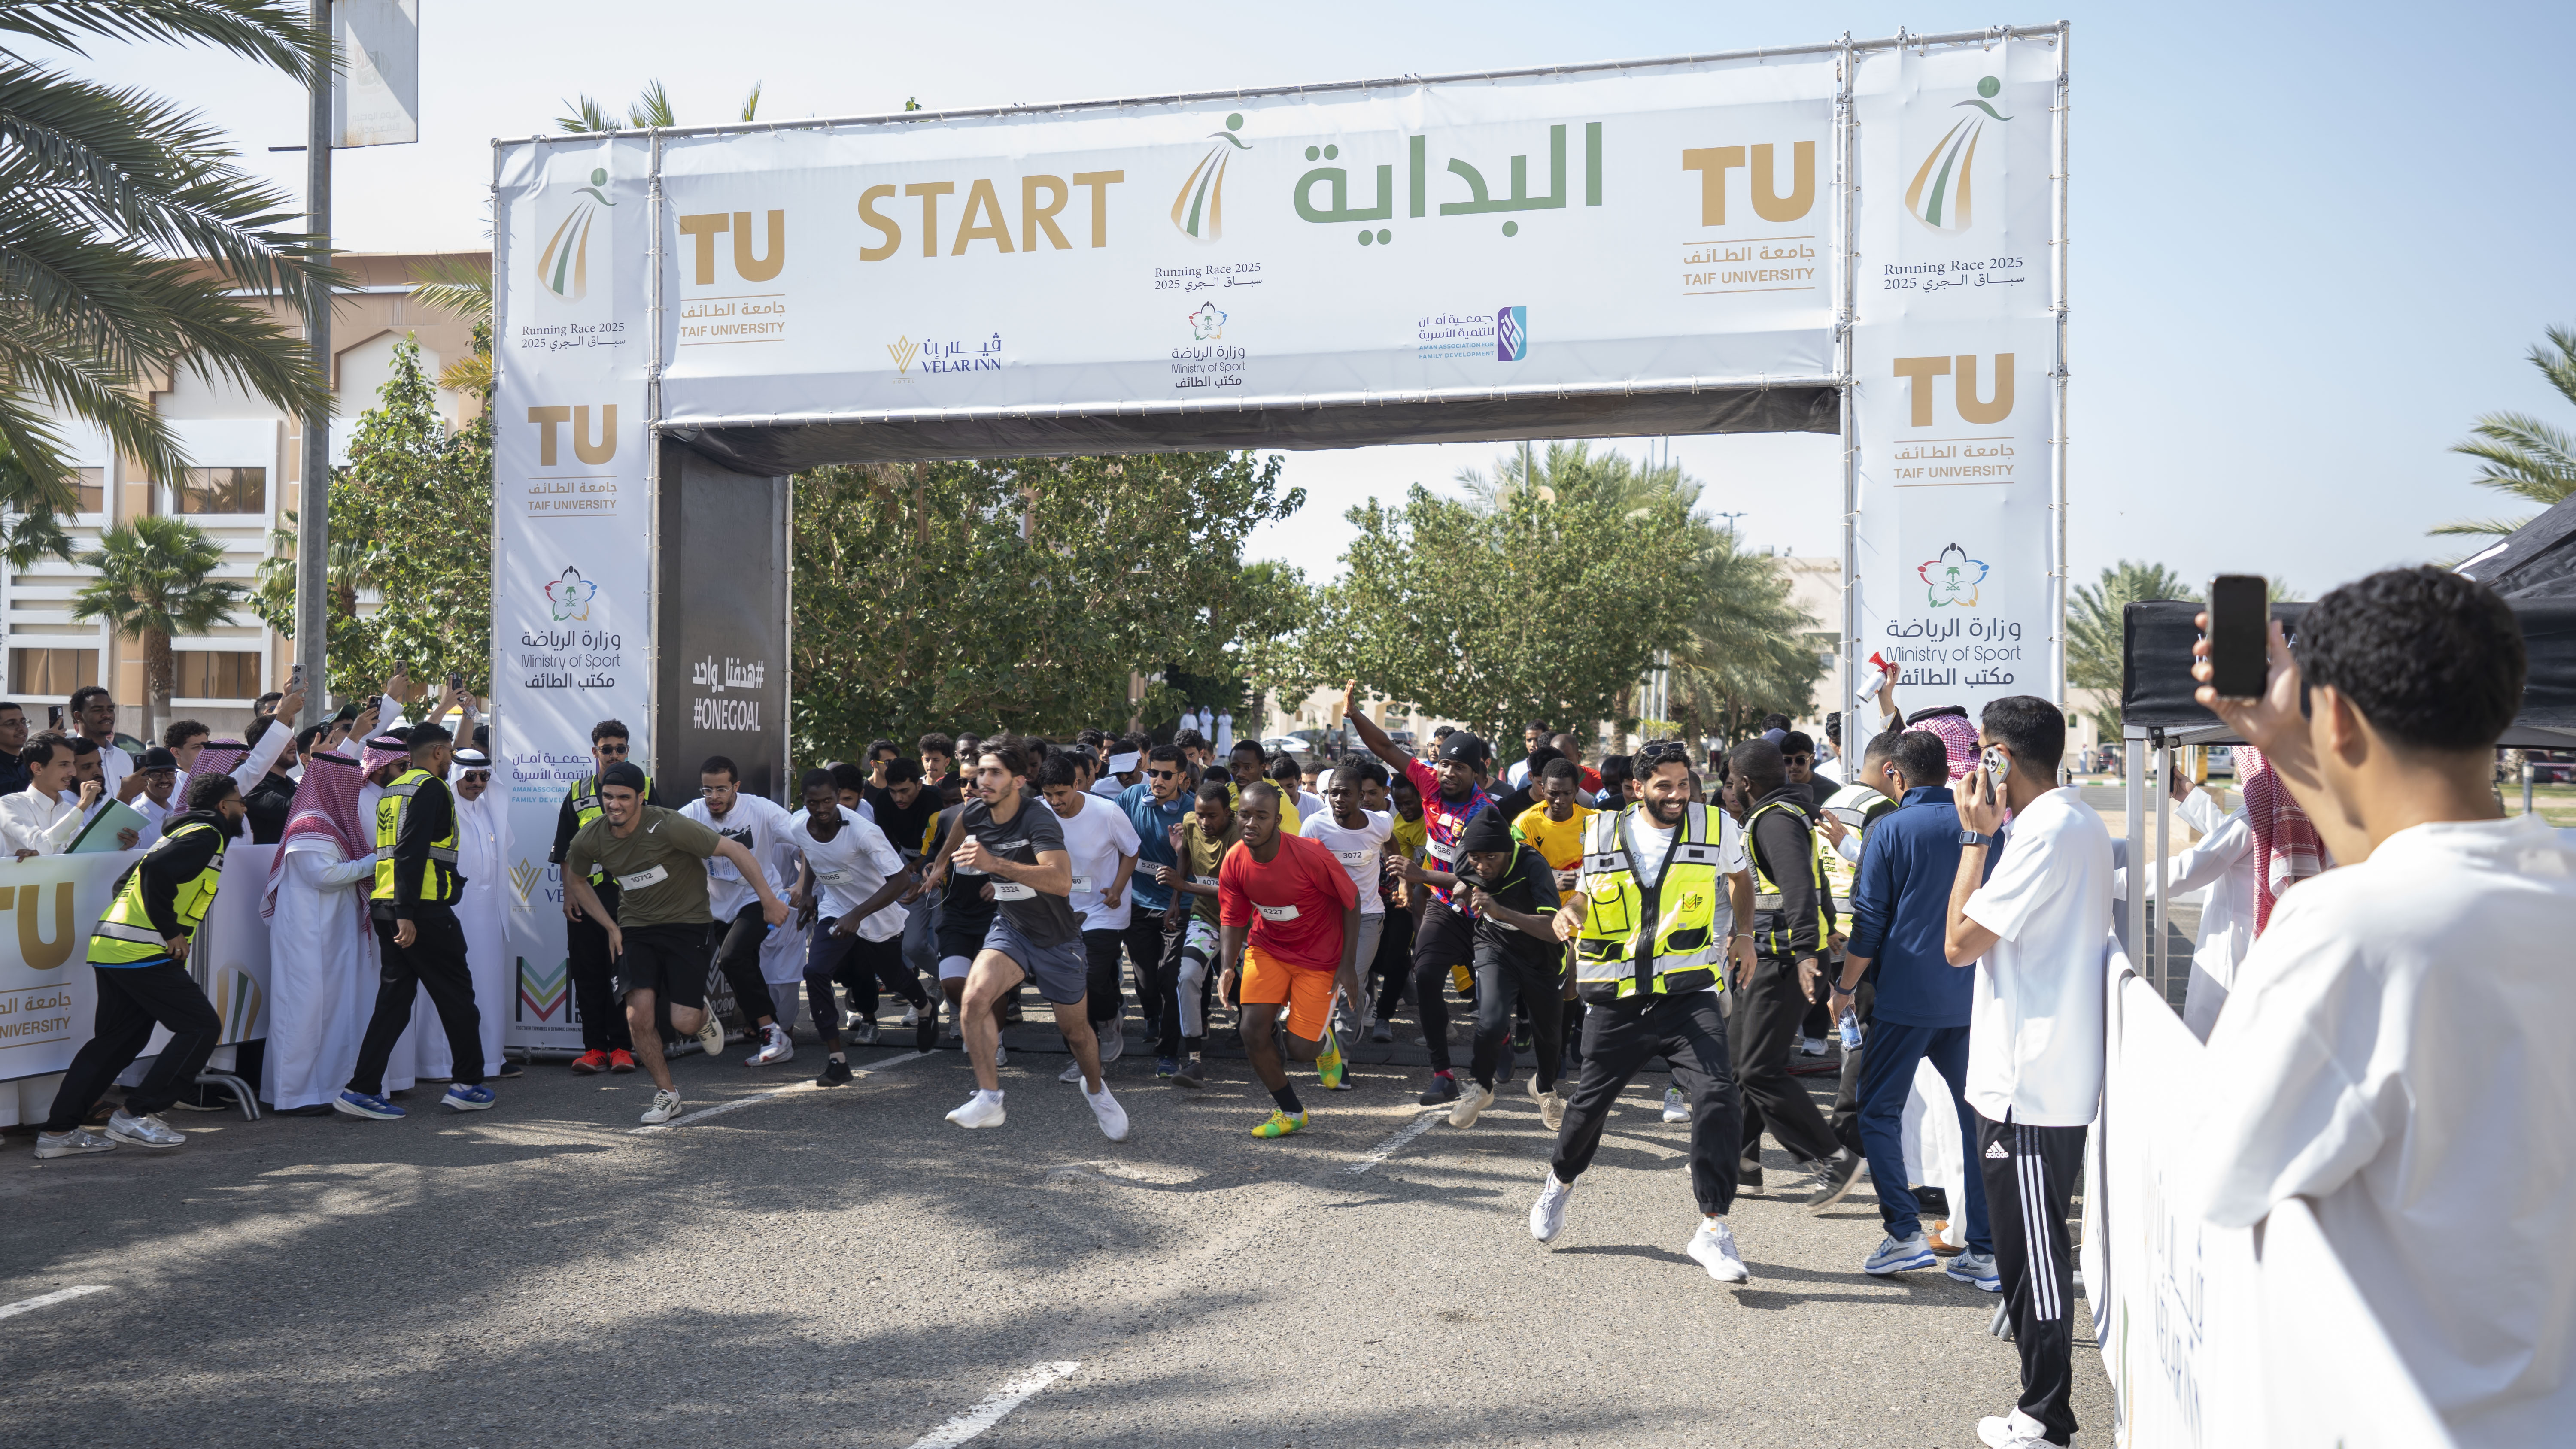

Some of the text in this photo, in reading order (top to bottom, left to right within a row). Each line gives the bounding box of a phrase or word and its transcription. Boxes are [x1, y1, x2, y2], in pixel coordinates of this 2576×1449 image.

[1294, 122, 1602, 246] البداية
[1682, 140, 1816, 227] TU
[858, 170, 1124, 262] START
[680, 209, 785, 285] TU
[1683, 243, 1816, 264] جامعة الطائف
[1155, 263, 1261, 278] Running Race 2025
[1884, 256, 2024, 276] Running Race 2025
[1155, 276, 1262, 293] سباق الجري 2025
[1683, 267, 1816, 285] TAIF UNIVERSITY
[1883, 273, 2026, 294] سباق الجري 2025
[681, 301, 786, 318] جامعة الطائف
[1419, 313, 1494, 327] جمعية أمان
[522, 322, 625, 337] Running Race 2025
[680, 322, 785, 337] TAIF UNIVERSITY
[1419, 327, 1495, 342] للتنمية الأسرية
[522, 336, 626, 352] سباق الجري 2025
[1172, 345, 1245, 361] وزارة الرياضة
[921, 358, 1001, 373] VELAR INN
[1172, 361, 1245, 374] Ministry of Sport
[1175, 374, 1242, 388] مكتب الطائف
[1893, 352, 2015, 427] TU
[528, 404, 617, 466] TU
[1894, 443, 2015, 461] جامعة الطائف
[1893, 464, 2015, 479] TAIF UNIVERSITY
[528, 482, 617, 495] جامعة الطائف
[528, 499, 617, 510] TAIF UNIVERSITY
[1886, 618, 2021, 643] وزارة الرياضة
[521, 629, 621, 651] وزارة الرياضة
[521, 653, 621, 670] Ministry of Sport
[1886, 645, 2021, 664] Ministry of Sport
[525, 673, 615, 689] مكتب الطائف
[1965, 667, 2014, 689] مكتب
[694, 698, 761, 731] #ONEGOAL
[513, 750, 592, 766] جمعية أمان
[513, 768, 550, 782] الأسرية
[1434, 844, 1451, 855] 4886
[630, 873, 653, 882] 10712
[25, 991, 72, 1011] جامعة
